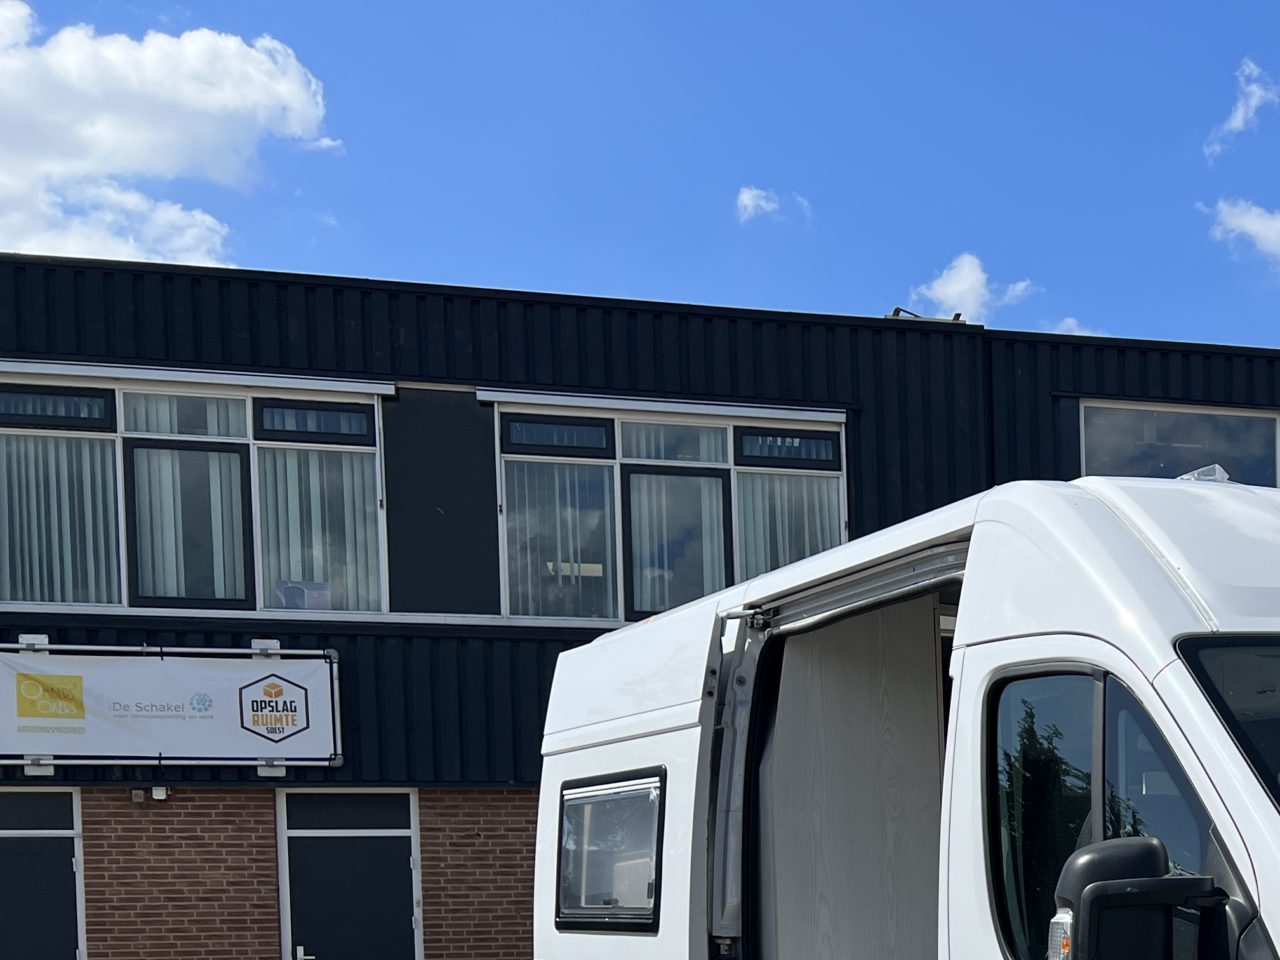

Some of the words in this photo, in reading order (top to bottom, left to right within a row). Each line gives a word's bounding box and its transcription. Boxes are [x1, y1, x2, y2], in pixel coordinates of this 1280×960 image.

[112, 701, 130, 712] De
[135, 701, 185, 713] Schakel
[251, 699, 297, 713] OPSLAG
[252, 713, 298, 727] RUIMTE
[266, 726, 285, 735] SOEST
